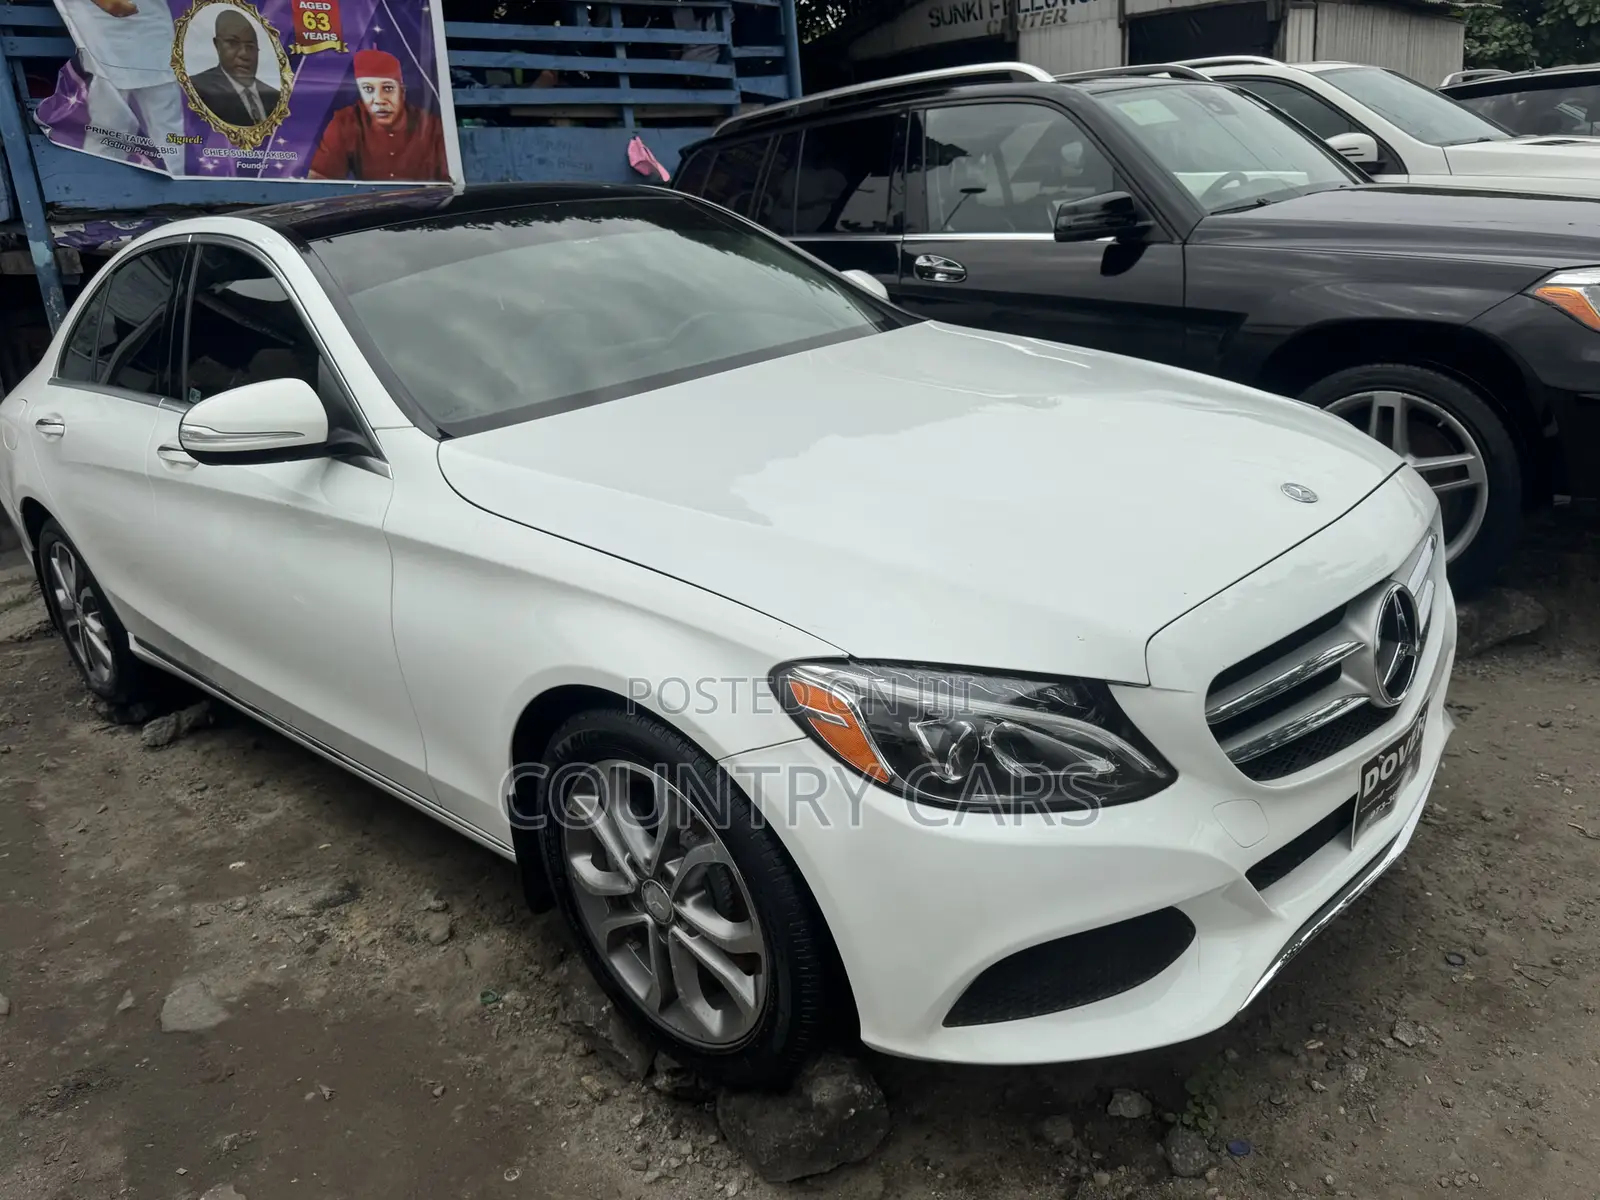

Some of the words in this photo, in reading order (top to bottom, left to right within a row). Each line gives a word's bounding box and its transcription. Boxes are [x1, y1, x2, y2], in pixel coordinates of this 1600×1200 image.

[299, 1, 331, 10] AGED
[303, 11, 331, 31] 63
[986, 8, 1067, 35] CNTER
[302, 32, 338, 41] YEARS
[85, 125, 122, 139] PRINCE
[124, 133, 154, 147] TAIWO
[166, 133, 203, 145] Signed:
[101, 138, 132, 152] Acting
[203, 148, 229, 157] CHIEF
[230, 149, 264, 159] SUNDAY
[236, 161, 269, 169] Founder
